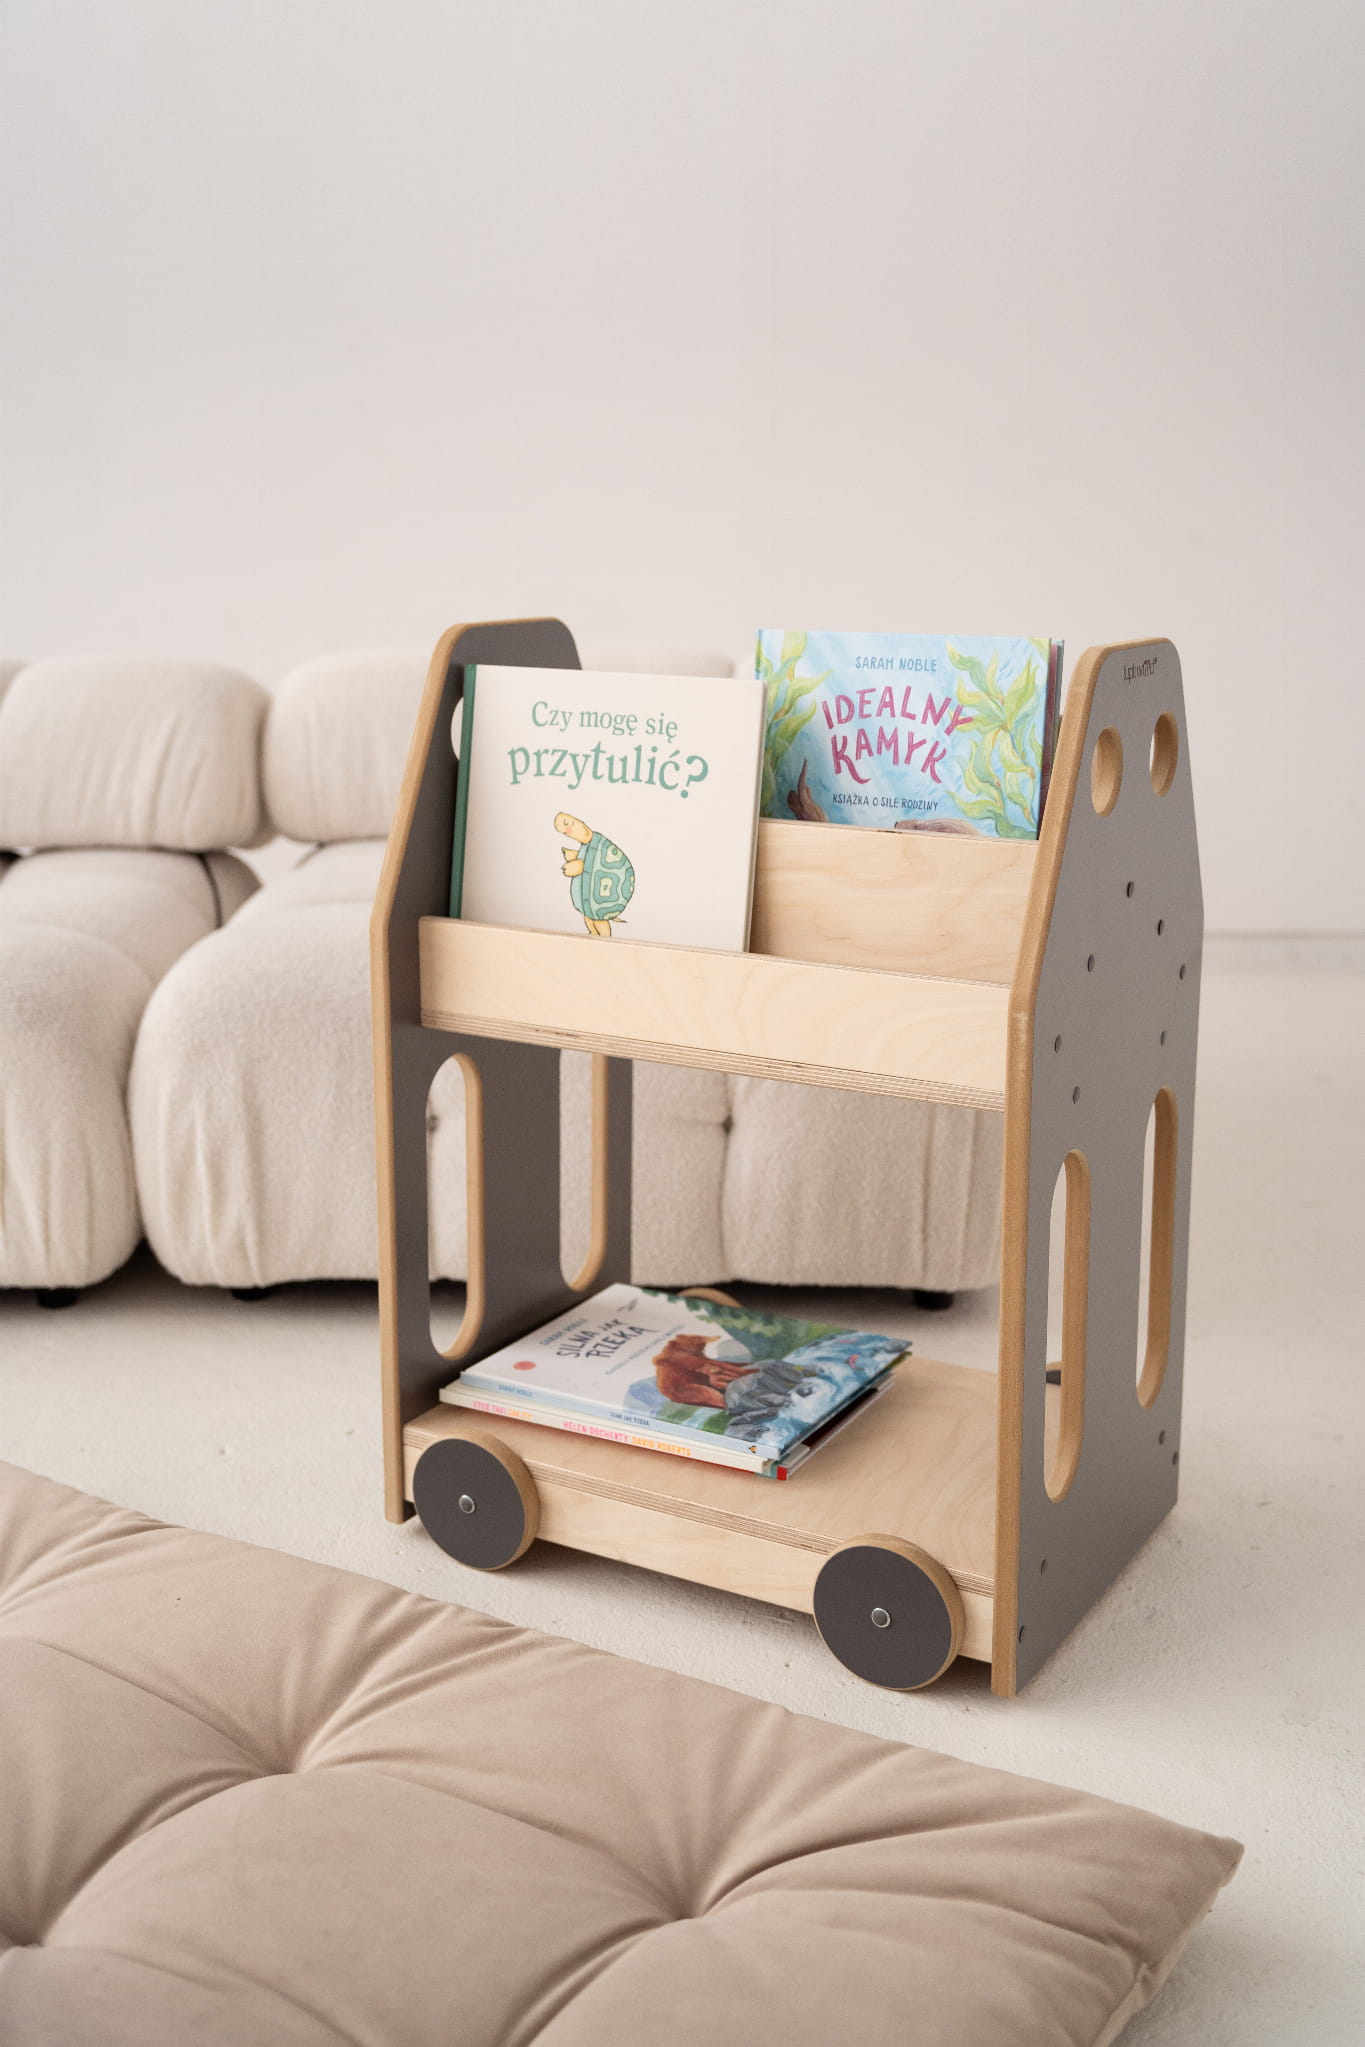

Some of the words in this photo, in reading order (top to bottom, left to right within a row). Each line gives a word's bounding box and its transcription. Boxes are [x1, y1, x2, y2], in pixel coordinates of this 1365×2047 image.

[856, 656, 894, 670] SARAH
[899, 657, 937, 672] NOBLE
[531, 701, 573, 732] Czy
[578, 710, 638, 736] mogę
[645, 712, 678, 743] się
[821, 685, 974, 736] IDEALNY
[507, 740, 709, 799] przytulić?
[831, 726, 947, 784] KAMYK
[832, 792, 870, 807] KSIĄŻKA
[872, 796, 879, 807] O
[880, 796, 899, 808] SILE
[901, 798, 939, 811] RODZINY
[585, 1325, 660, 1358] RZEKA
[563, 1420, 587, 1433] HELEN
[589, 1426, 629, 1443] DOCHERTY
[631, 1435, 655, 1450] DAVID
[657, 1441, 691, 1457] ROBERTS
